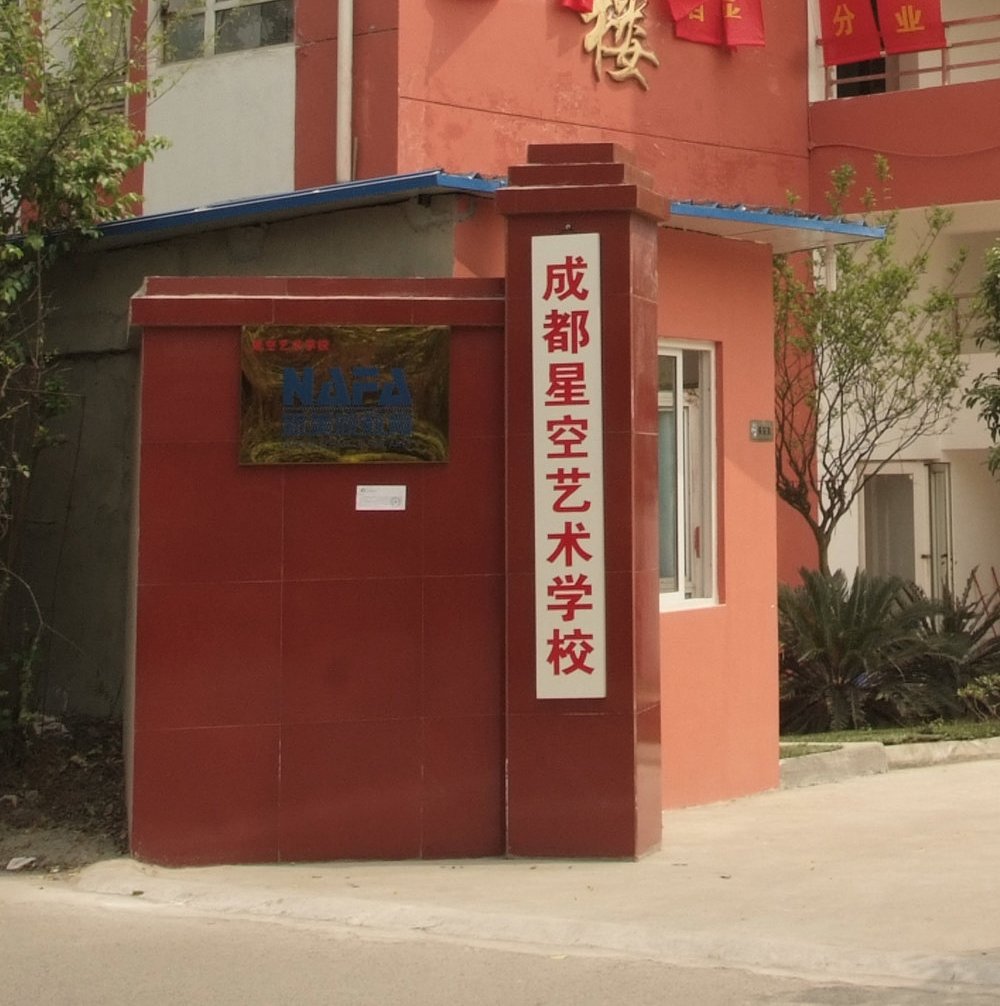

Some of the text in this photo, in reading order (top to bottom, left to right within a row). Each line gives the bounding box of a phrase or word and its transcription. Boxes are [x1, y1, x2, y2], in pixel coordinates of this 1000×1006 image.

[283, 367, 412, 407] NAFA
[542, 255, 595, 677] 成都星空艺术学校
